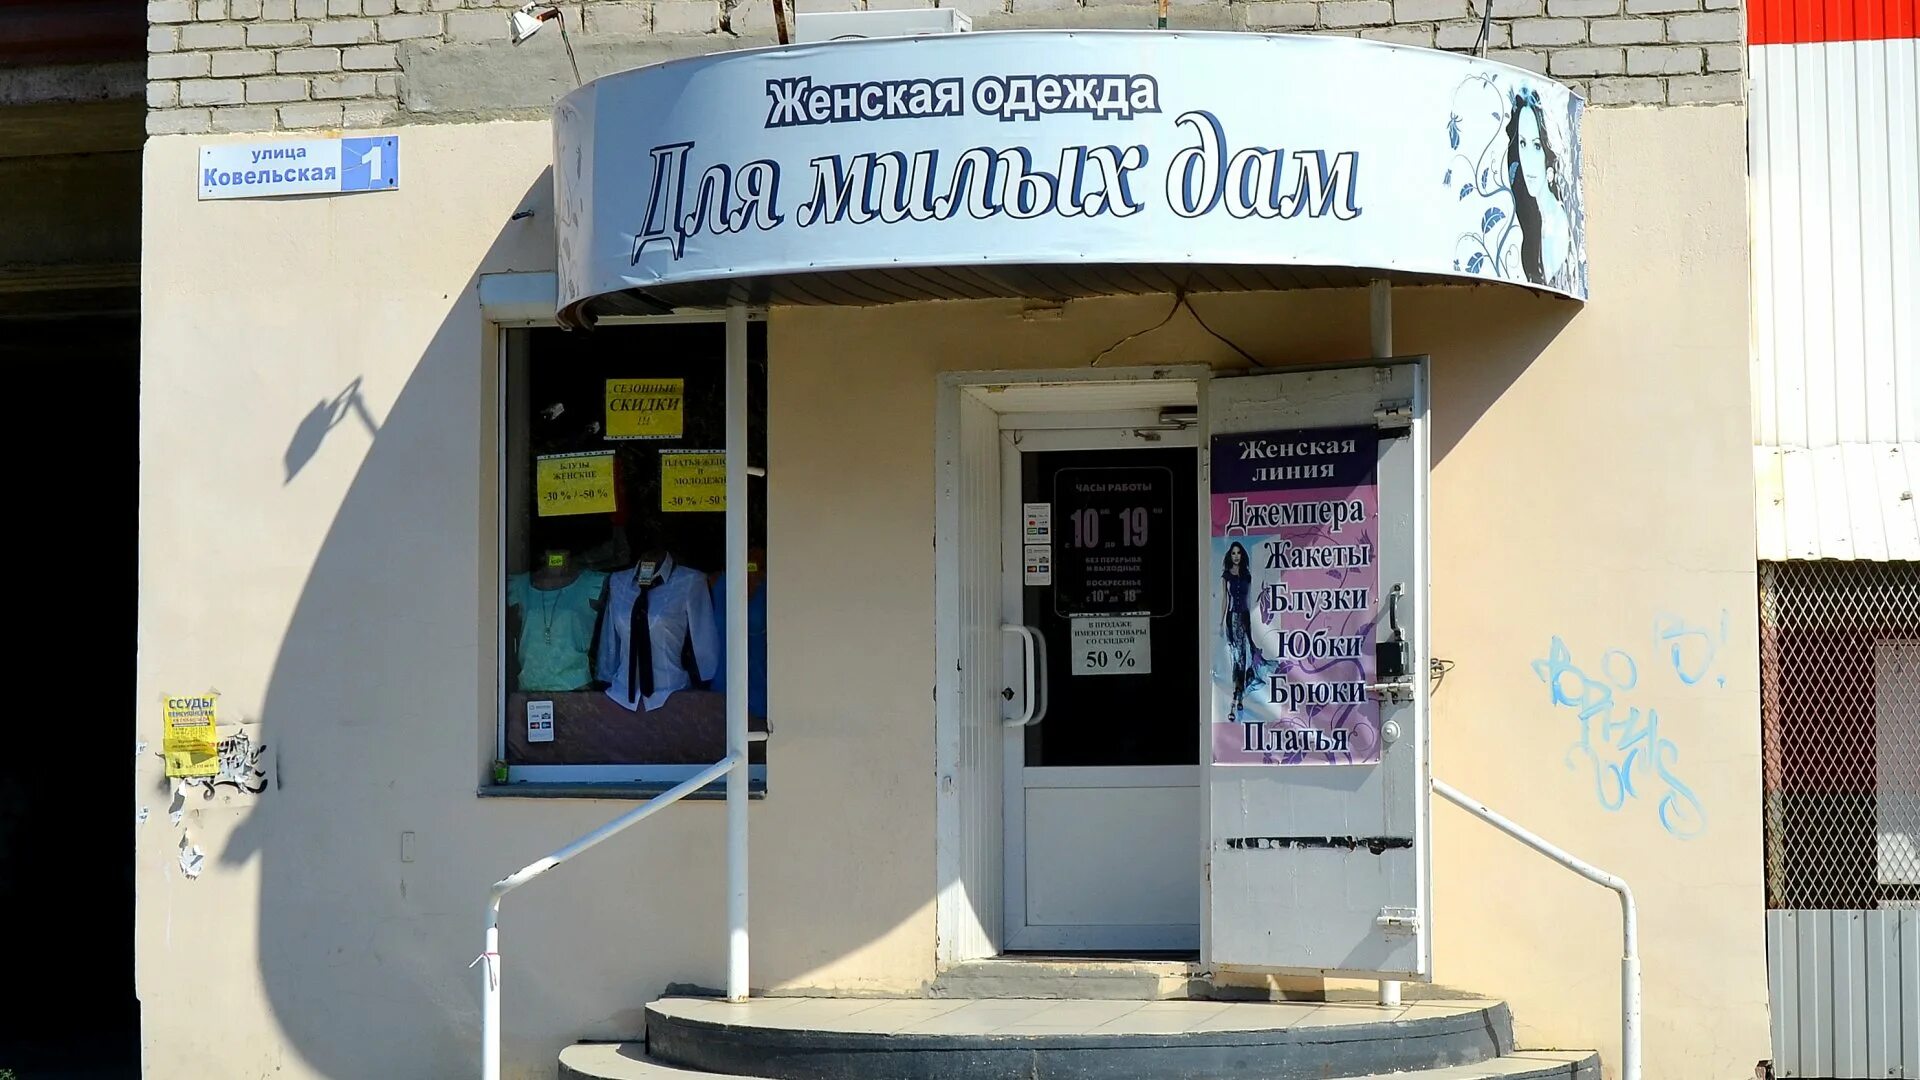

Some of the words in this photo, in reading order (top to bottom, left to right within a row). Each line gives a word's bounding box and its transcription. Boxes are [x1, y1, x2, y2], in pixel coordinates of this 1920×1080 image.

[765, 77, 964, 128] Женская
[972, 74, 1161, 122] одежда
[251, 146, 307, 164] улица
[361, 146, 382, 181] 1
[204, 166, 336, 187] Ковельская
[631, 142, 785, 265] Для
[799, 144, 1148, 228] милых
[1166, 110, 1362, 221] дам
[613, 384, 677, 393] СЕЗОННЫЕ
[610, 398, 680, 413] СКИДКИ
[1238, 439, 1356, 460] Женская
[553, 470, 597, 480] ЖЕНСКИЕ
[1252, 464, 1335, 482] линия
[543, 491, 558, 501] -30
[579, 490, 595, 499] -50
[1075, 483, 1105, 492] ЧАСЫ
[1108, 482, 1152, 492] РАБОТЫ
[1225, 497, 1366, 537] Джемпера
[1070, 508, 1099, 549] 10
[1119, 506, 1148, 547] 19
[1263, 540, 1371, 570] Жакеты
[1269, 583, 1368, 620] Блузки
[1095, 621, 1132, 629] ПРОДАЖЕ
[1116, 628, 1147, 636] ТОВАРЫ
[1098, 636, 1135, 645] СКИДКОЙ
[1276, 630, 1363, 660] Юбки
[1086, 651, 1108, 668] 50
[1115, 650, 1136, 667] %
[1268, 674, 1369, 714] Брюки
[168, 698, 214, 710] ССУДЫ
[1242, 720, 1349, 753] Платья
